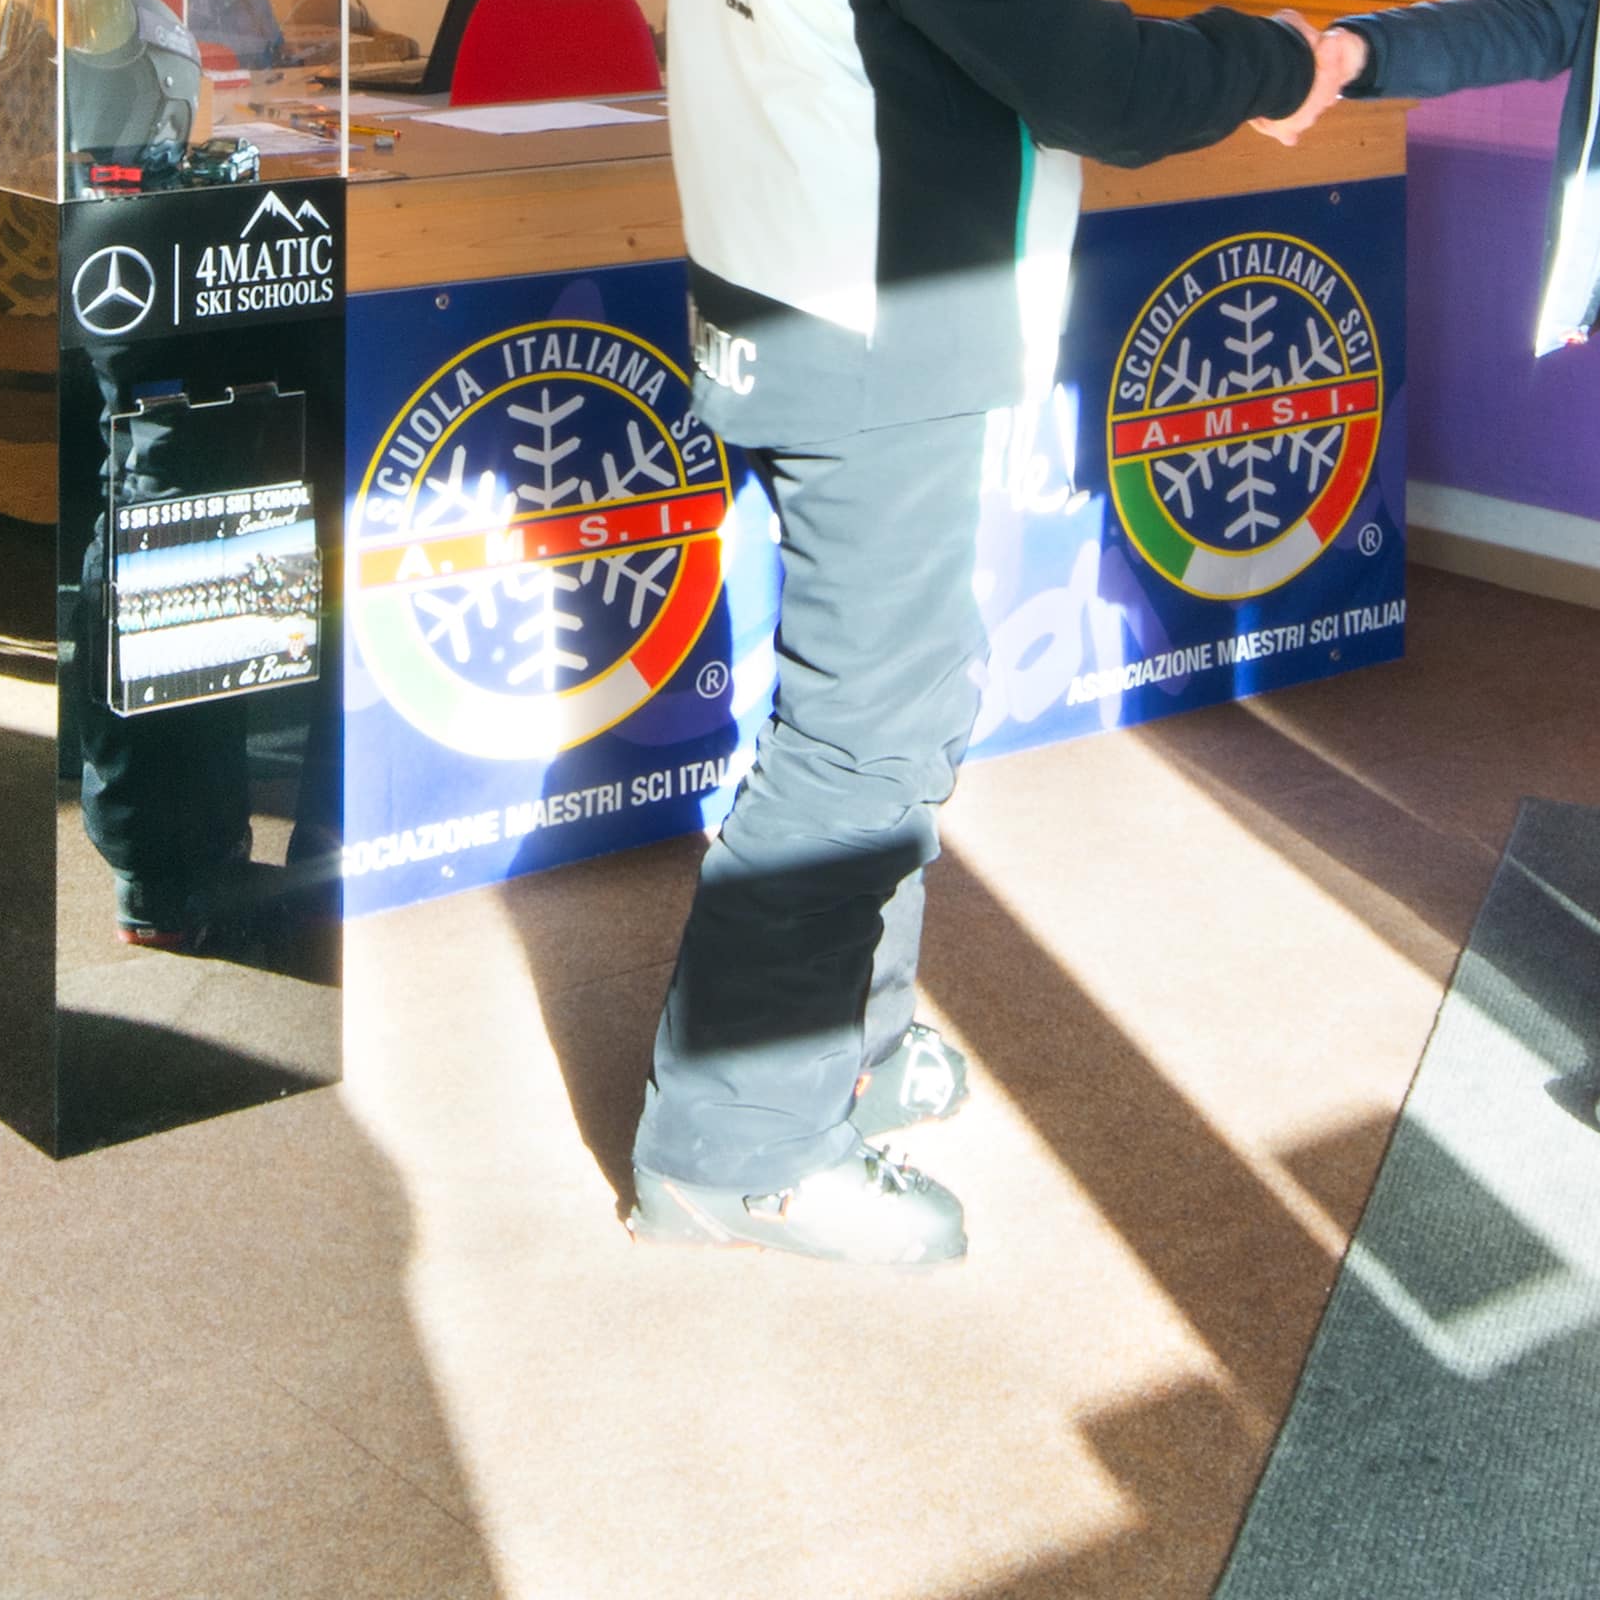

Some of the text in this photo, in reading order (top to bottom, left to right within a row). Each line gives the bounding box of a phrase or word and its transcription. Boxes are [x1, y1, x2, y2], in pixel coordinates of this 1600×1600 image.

[195, 235, 333, 288] 4MATIC
[195, 278, 335, 317] SKI SCHOOLS
[1119, 242, 1374, 404] SCUOLA ITALIANA SCI
[366, 333, 718, 527] SCUOLA ITALIANA SCI
[1067, 598, 1407, 707] ASSOCIAZIONE MAESTRI SCI ITALIA
[504, 780, 624, 838] MAESTRI
[630, 769, 672, 807] SCI
